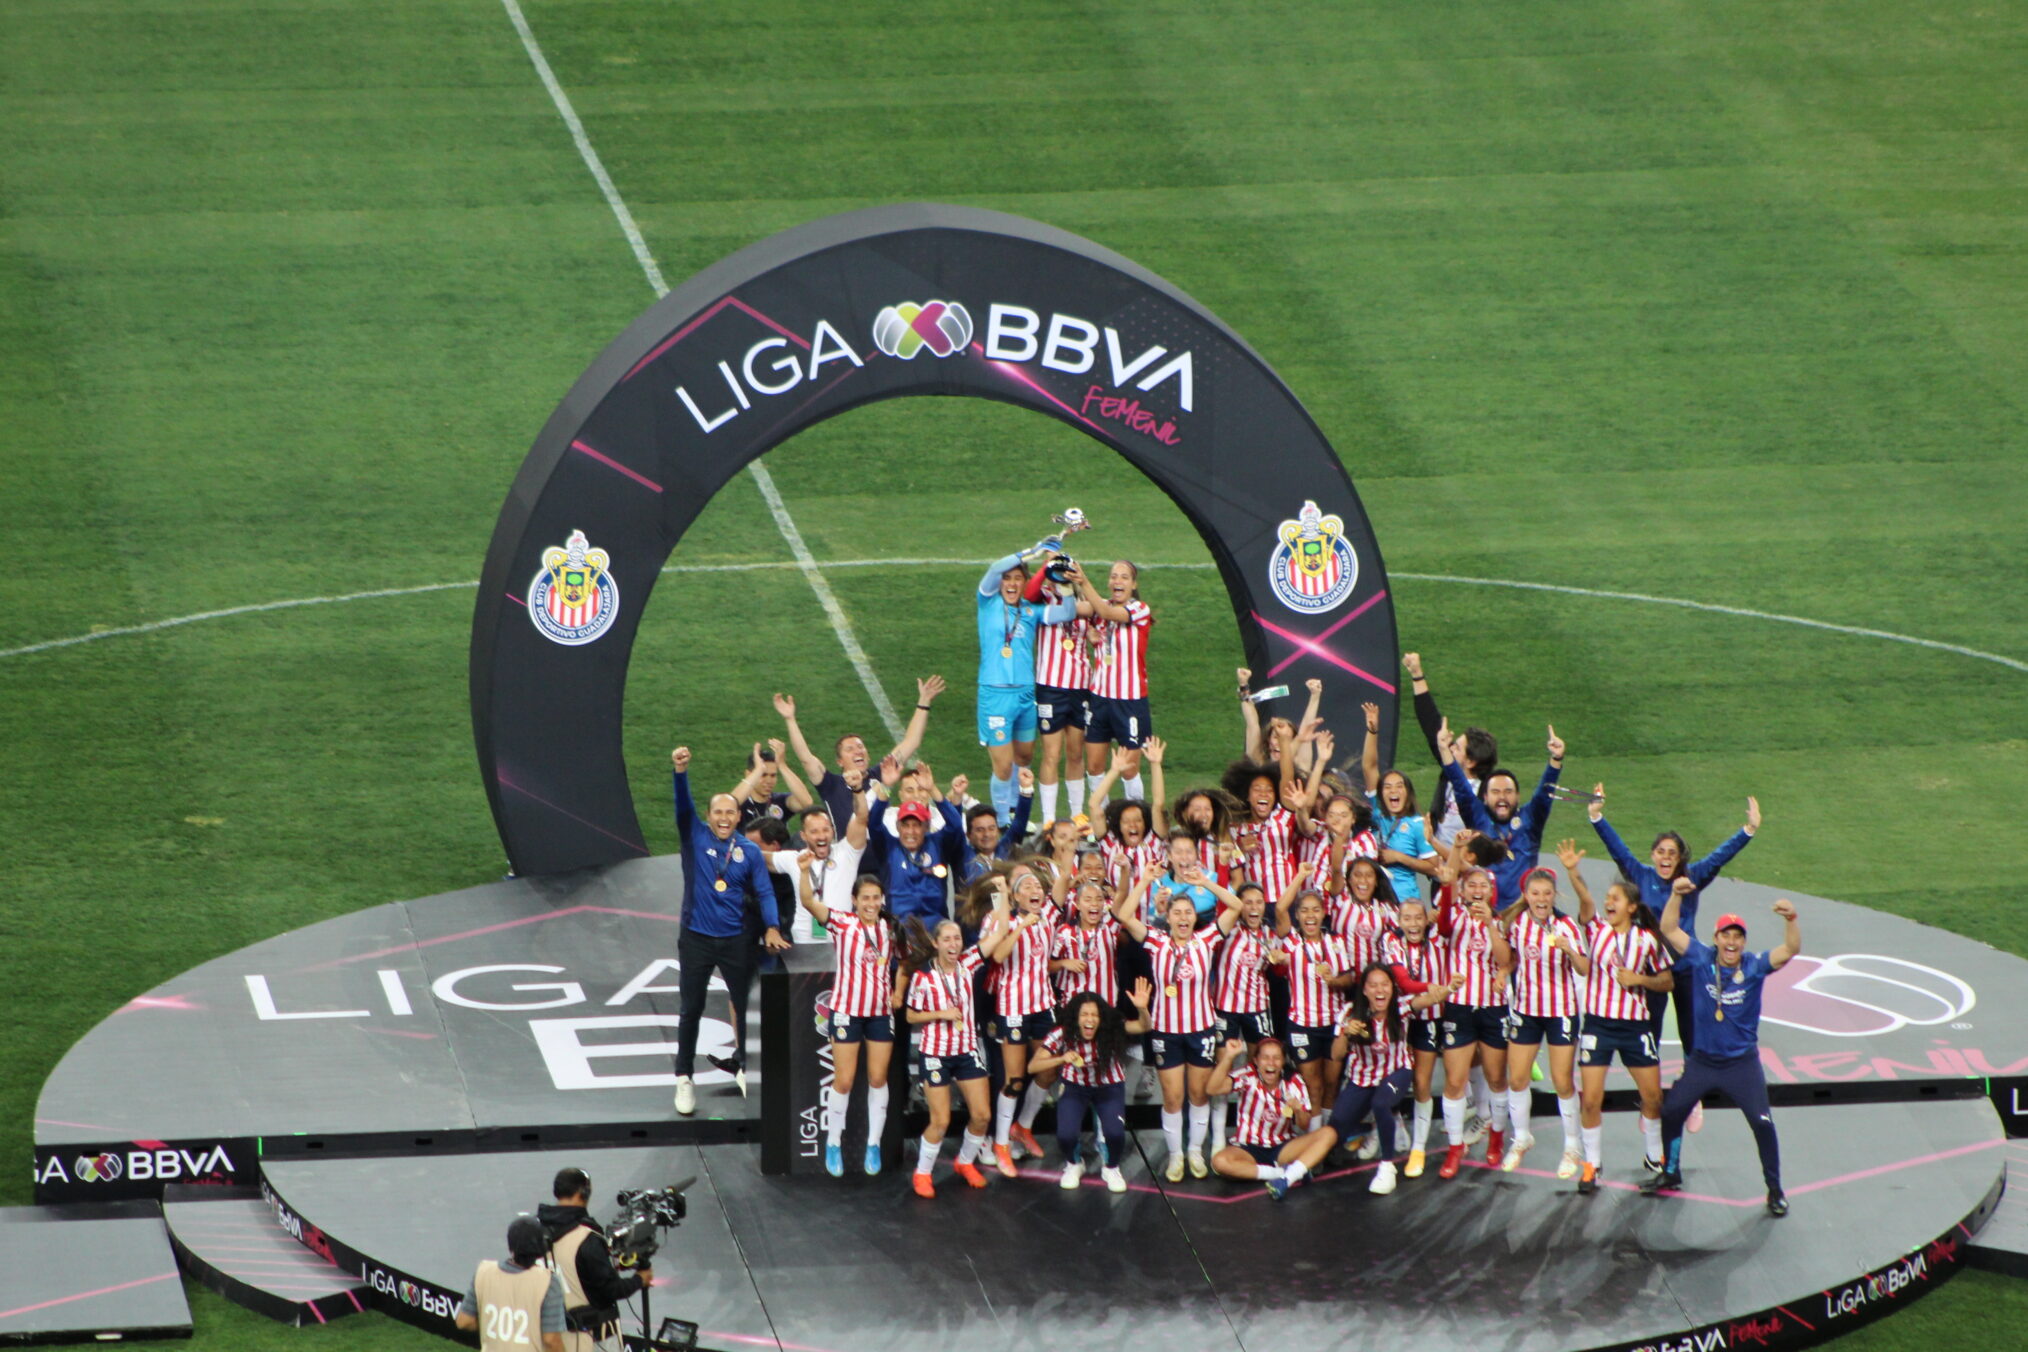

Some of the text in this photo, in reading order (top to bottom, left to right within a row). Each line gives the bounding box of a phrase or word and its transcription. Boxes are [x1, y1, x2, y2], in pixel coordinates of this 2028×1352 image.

[675, 303, 1192, 434] LIGA BBVA
[244, 958, 730, 1021] LIGA
[800, 1105, 819, 1157] LIGA
[127, 1145, 235, 1180] BBVA
[422, 1288, 461, 1320] BBV
[1827, 1284, 1866, 1319] LIGA
[484, 1303, 530, 1344] 202
